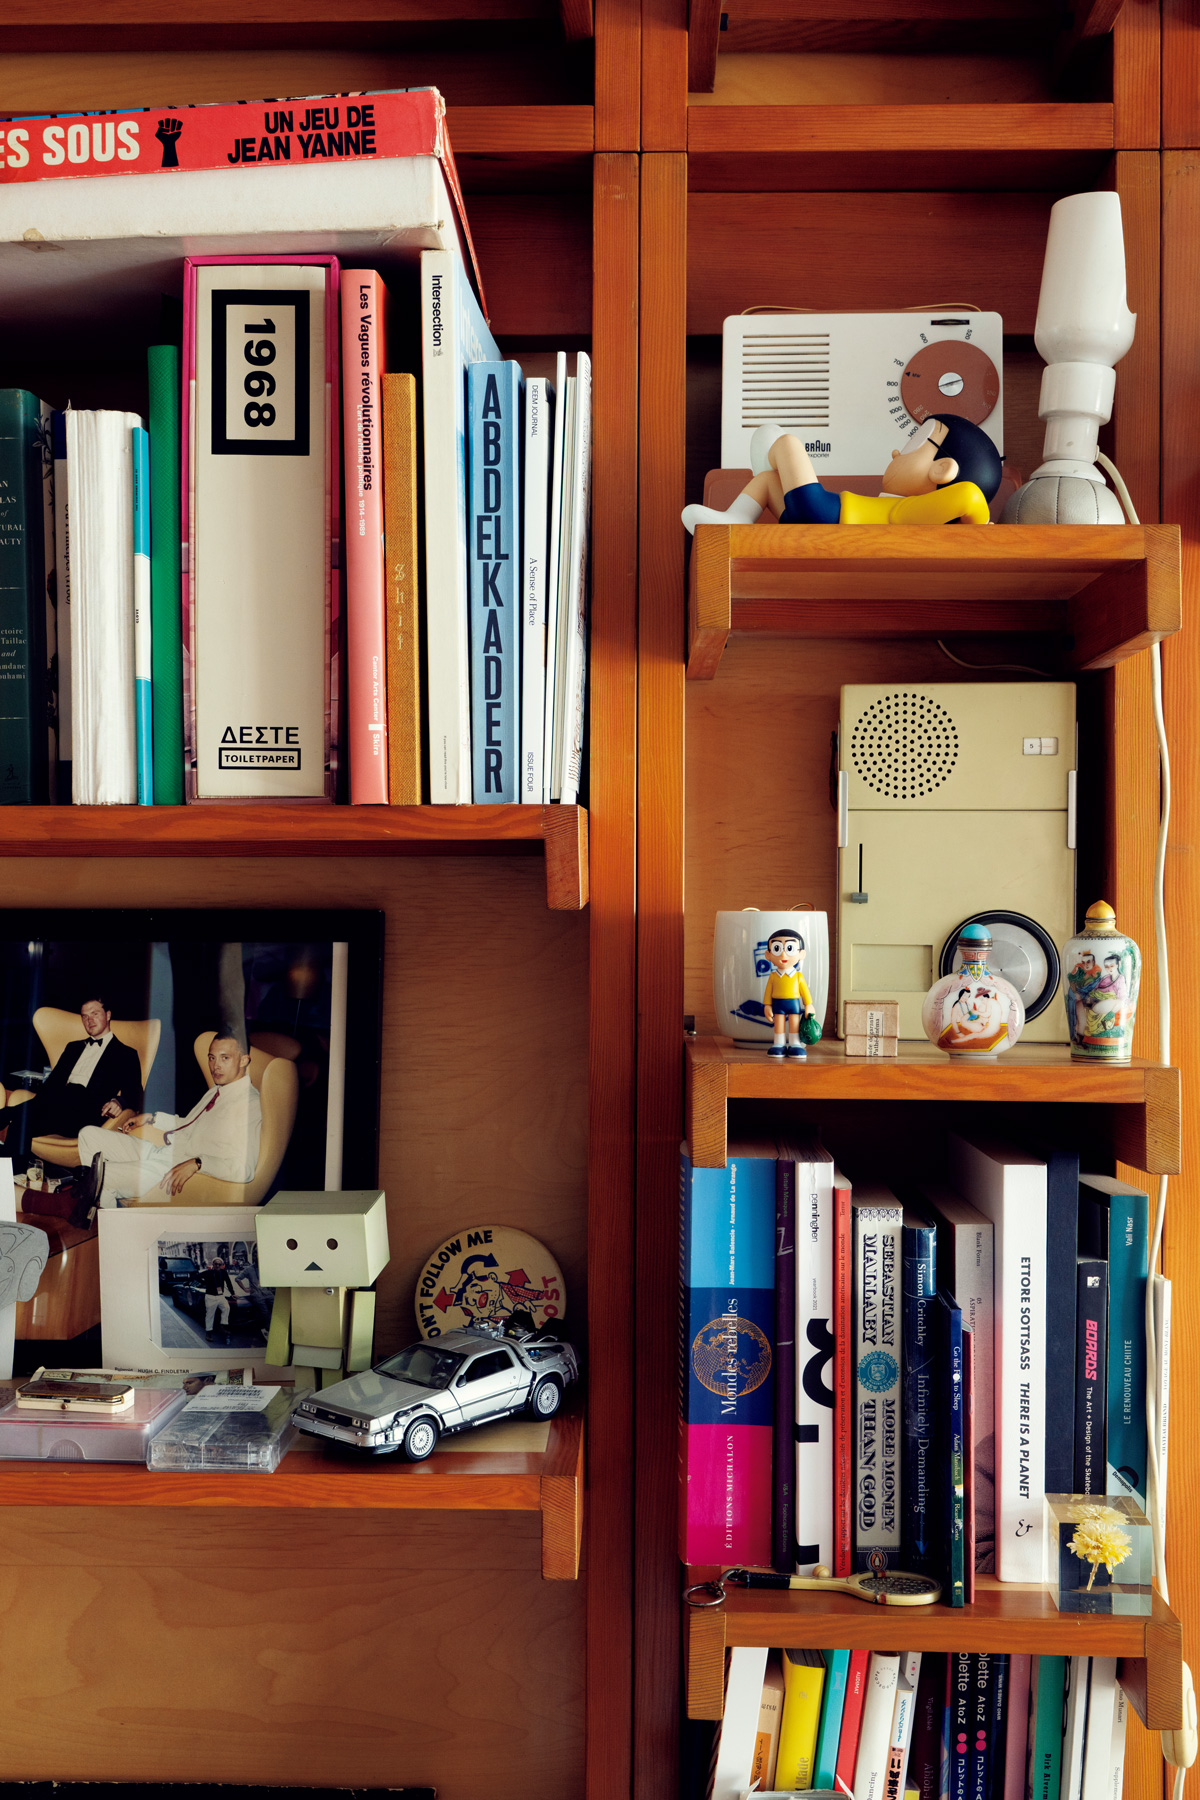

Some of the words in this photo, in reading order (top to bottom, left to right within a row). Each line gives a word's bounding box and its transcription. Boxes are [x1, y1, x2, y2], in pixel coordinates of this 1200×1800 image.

[264, 110, 293, 134] UN
[299, 107, 340, 131] JEU
[347, 104, 375, 127] DE
[0, 128, 30, 168] S
[43, 121, 140, 166] SOUS
[227, 135, 291, 163] JEAN
[296, 129, 376, 158] YANNE
[359, 285, 371, 309] Les
[432, 275, 444, 347] Intersection
[358, 314, 372, 367] Vagues
[244, 318, 276, 428] 1968
[893, 358, 904, 367] 700
[889, 405, 903, 414] 1000
[895, 413, 908, 423] 1100
[898, 419, 912, 430] 1200
[361, 372, 374, 490] révolutionnaires
[805, 440, 831, 452] BRAUN
[530, 557, 538, 565] A
[477, 374, 509, 793] ABDELKADER
[529, 566, 538, 591] Sense
[529, 593, 538, 602] of
[529, 604, 538, 626] Place
[224, 754, 295, 763] TOILETPAPER
[730, 1194, 736, 1202] de
[810, 1193, 820, 1243] penninghen
[1125, 1233, 1133, 1246] Vali
[420, 1239, 463, 1298] FOLLOW
[467, 1230, 493, 1248] ME
[917, 1263, 927, 1296] Simon
[1021, 1257, 1031, 1303] ETTORE
[538, 1275, 564, 1326] OST
[863, 1233, 878, 1346] MALLABY
[882, 1234, 895, 1347] SEBASTIAN
[722, 1298, 738, 1354] rebelles
[914, 1299, 927, 1347] Critchley
[1020, 1307, 1030, 1370] SOTTSASS
[953, 1346, 961, 1357] Go
[953, 1358, 961, 1368] the
[1085, 1319, 1098, 1381] BOARDS
[1124, 1339, 1132, 1365] CHIITE
[721, 1358, 738, 1415] Mondes
[952, 1393, 961, 1411] Sleep
[1020, 1382, 1030, 1421] THERE
[914, 1373, 930, 1434] Infinitely
[1123, 1415, 1131, 1425] LE
[860, 1398, 876, 1472] THAN
[882, 1398, 896, 1458] MORE
[1020, 1423, 1030, 1435] IS
[1020, 1437, 1030, 1447] A
[1084, 1421, 1092, 1445] Design
[726, 1435, 734, 1491] MICHALON
[914, 1438, 930, 1514] Demanding
[1019, 1449, 1029, 1499] PLANET
[859, 1474, 877, 1532] GOD
[882, 1460, 896, 1533] MONEY
[725, 1496, 733, 1549] ÉDITIONS
[958, 1707, 966, 1717] to
[977, 1695, 986, 1703] A
[977, 1704, 985, 1714] to
[795, 1757, 810, 1785] Made
[1044, 1753, 1052, 1770] Dirk
